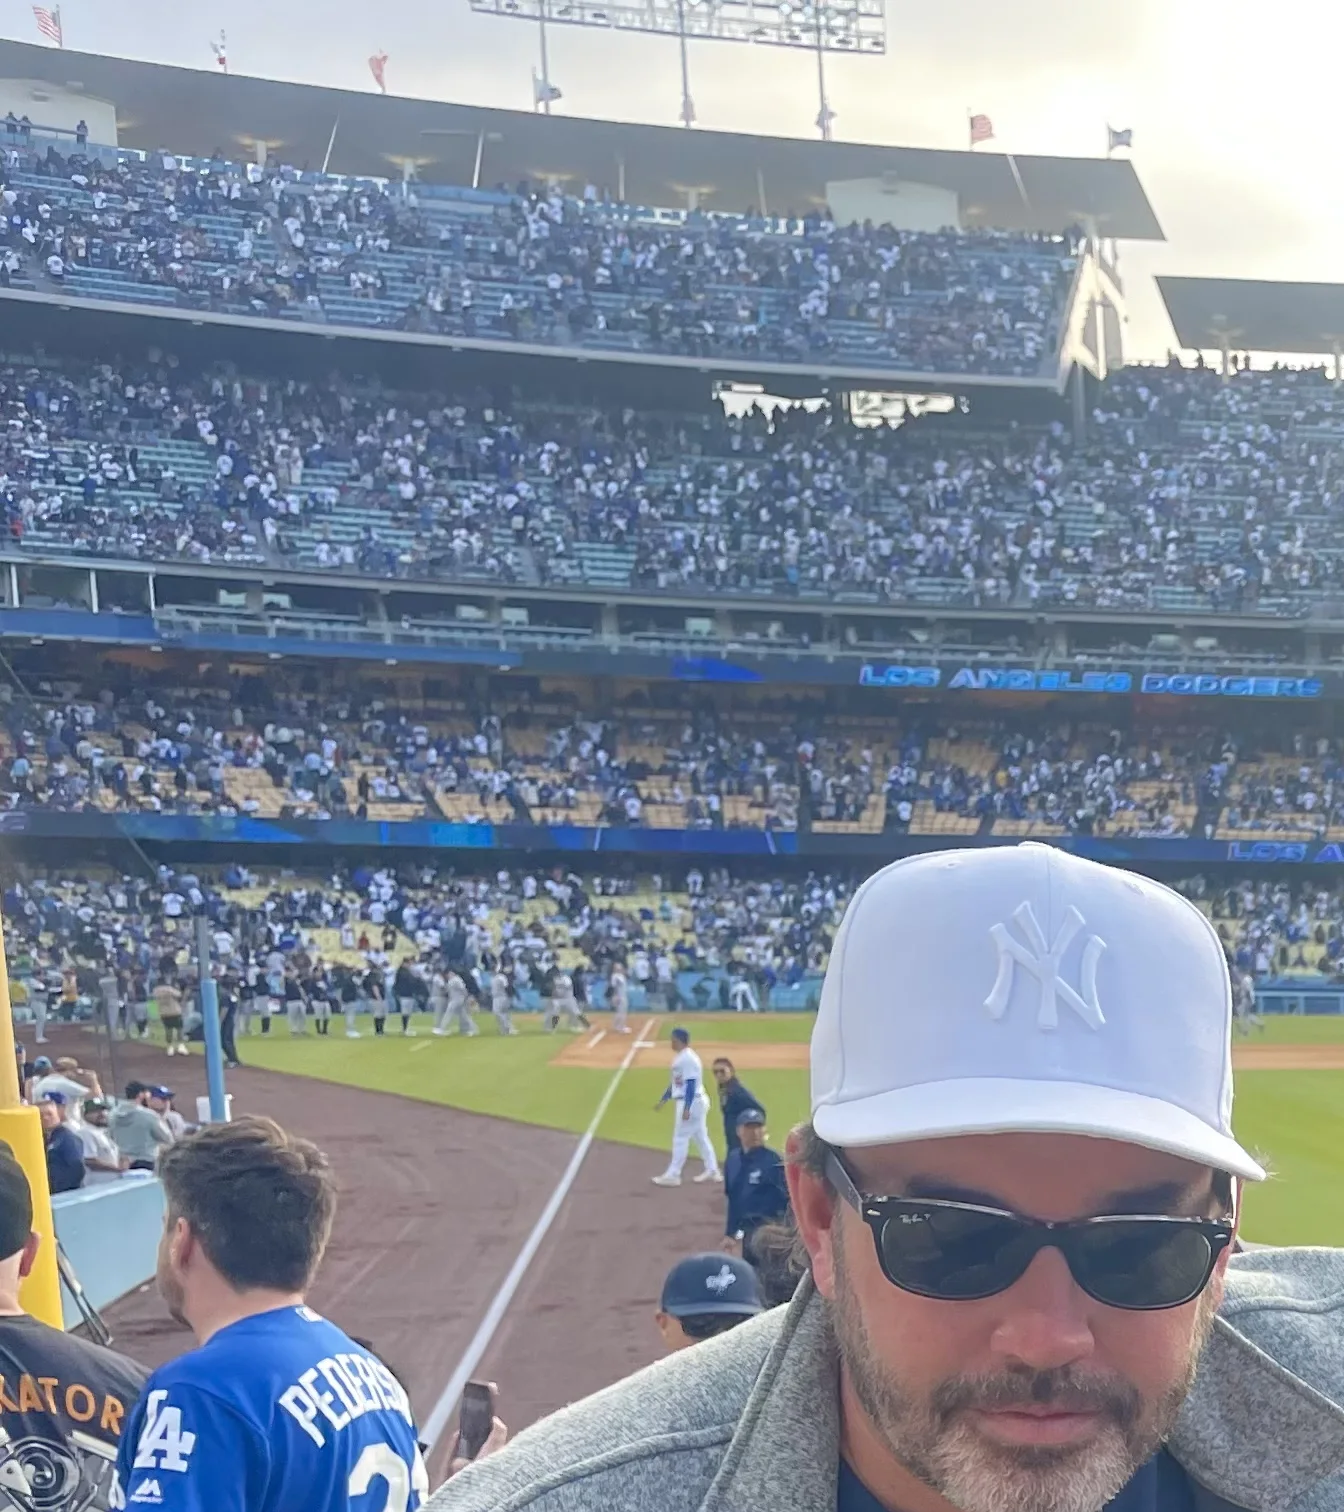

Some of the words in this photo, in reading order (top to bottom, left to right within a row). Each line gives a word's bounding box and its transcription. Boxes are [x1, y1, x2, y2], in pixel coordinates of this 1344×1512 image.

[859, 664, 940, 688] LOS
[947, 667, 1132, 693] ANGELES
[1141, 673, 1324, 697] DODGERS
[1227, 842, 1307, 863] LOS
